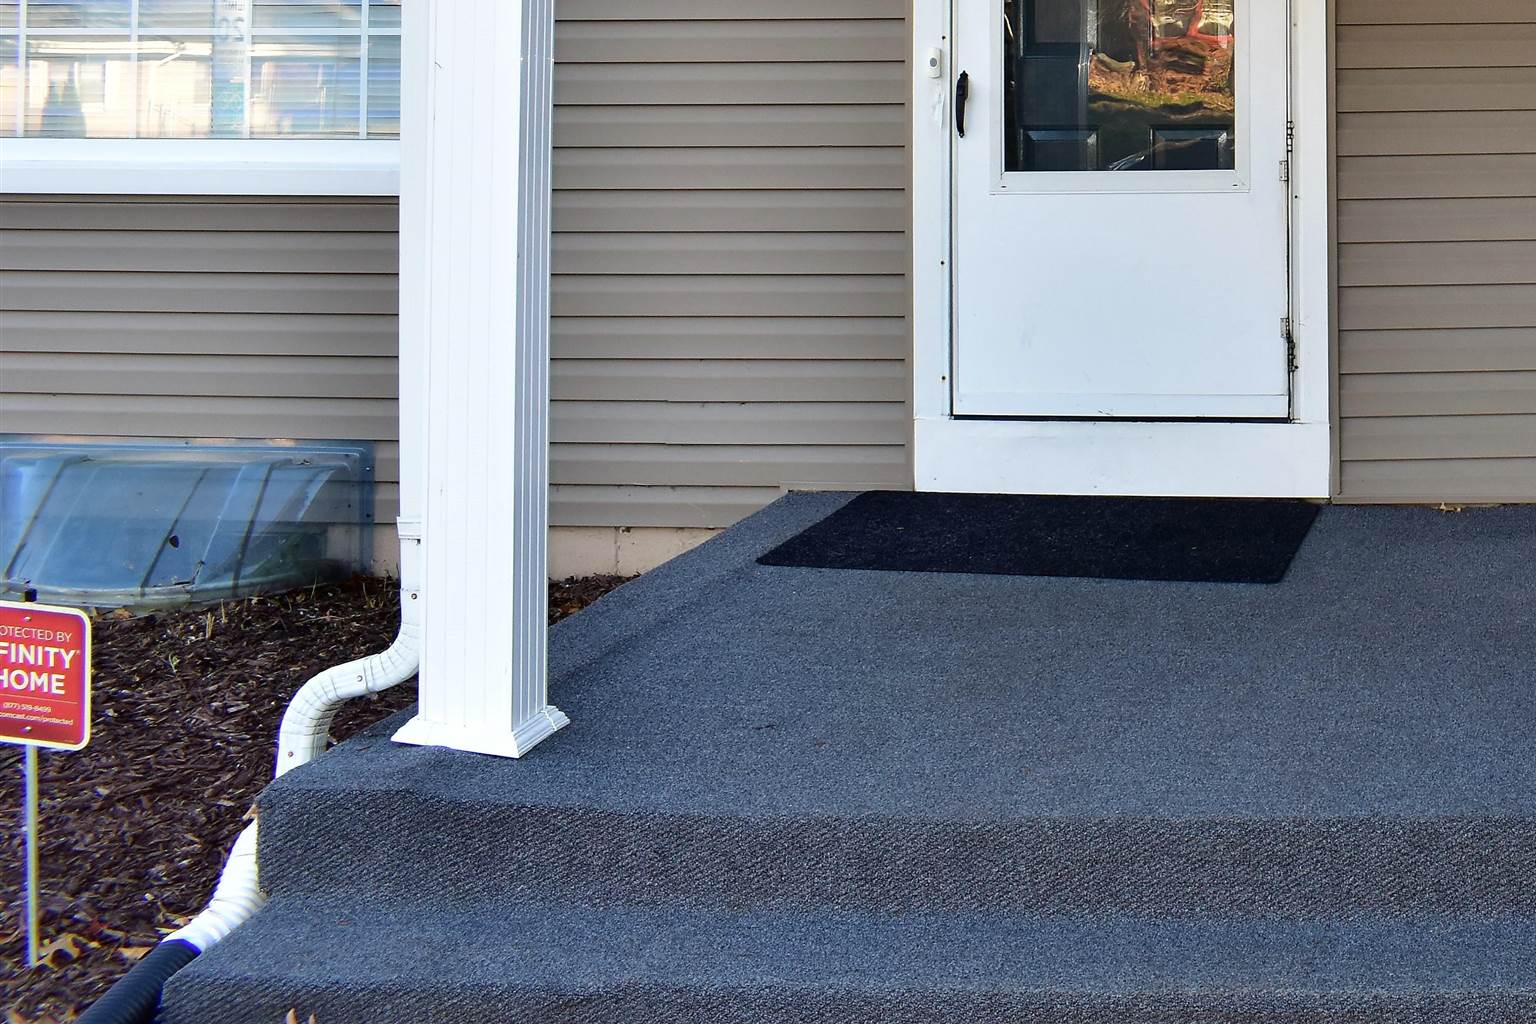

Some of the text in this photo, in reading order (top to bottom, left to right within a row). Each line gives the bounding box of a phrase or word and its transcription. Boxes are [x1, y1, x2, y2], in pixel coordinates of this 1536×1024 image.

[0, 625, 72, 643] OTECTED BY
[0, 641, 76, 669] FINITY
[0, 668, 65, 695] HOME
